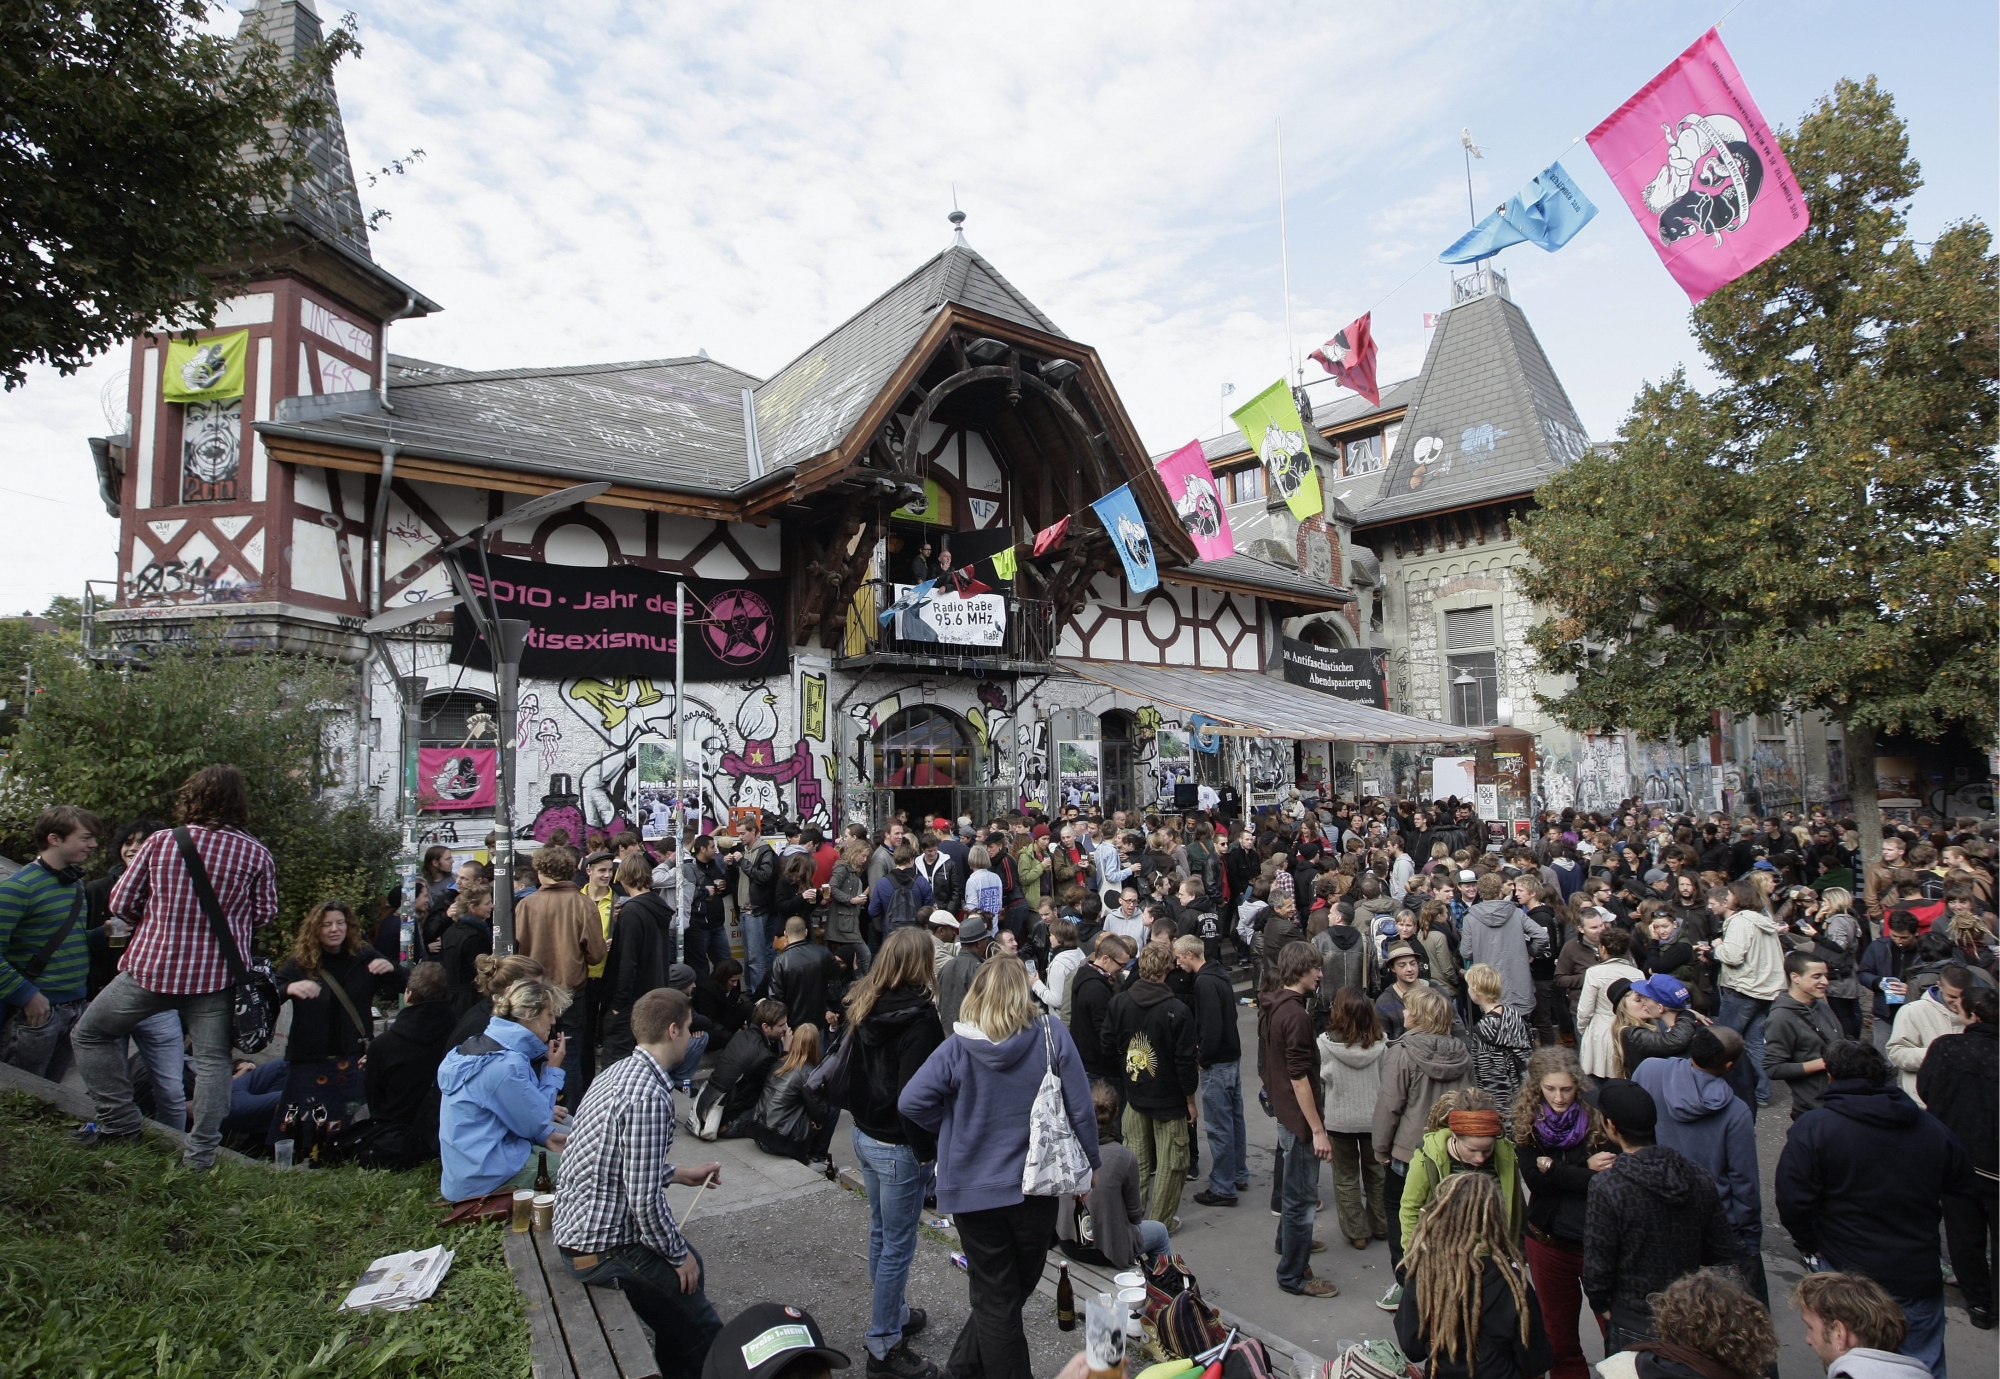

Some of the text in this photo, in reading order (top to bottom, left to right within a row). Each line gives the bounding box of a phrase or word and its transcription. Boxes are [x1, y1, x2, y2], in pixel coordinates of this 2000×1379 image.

[467, 572, 695, 616] 2010 Jahr des
[743, 591, 769, 614] SEXISM
[933, 601, 993, 613] Radio RaBe
[935, 612, 993, 626] 95.6 MHz
[480, 627, 678, 653] tisexismus
[1292, 651, 1354, 672] Antifaschistischen
[1309, 672, 1372, 691] Abendspaziergang
[640, 780, 666, 788] Preis:
[749, 1334, 775, 1353] Preis:
